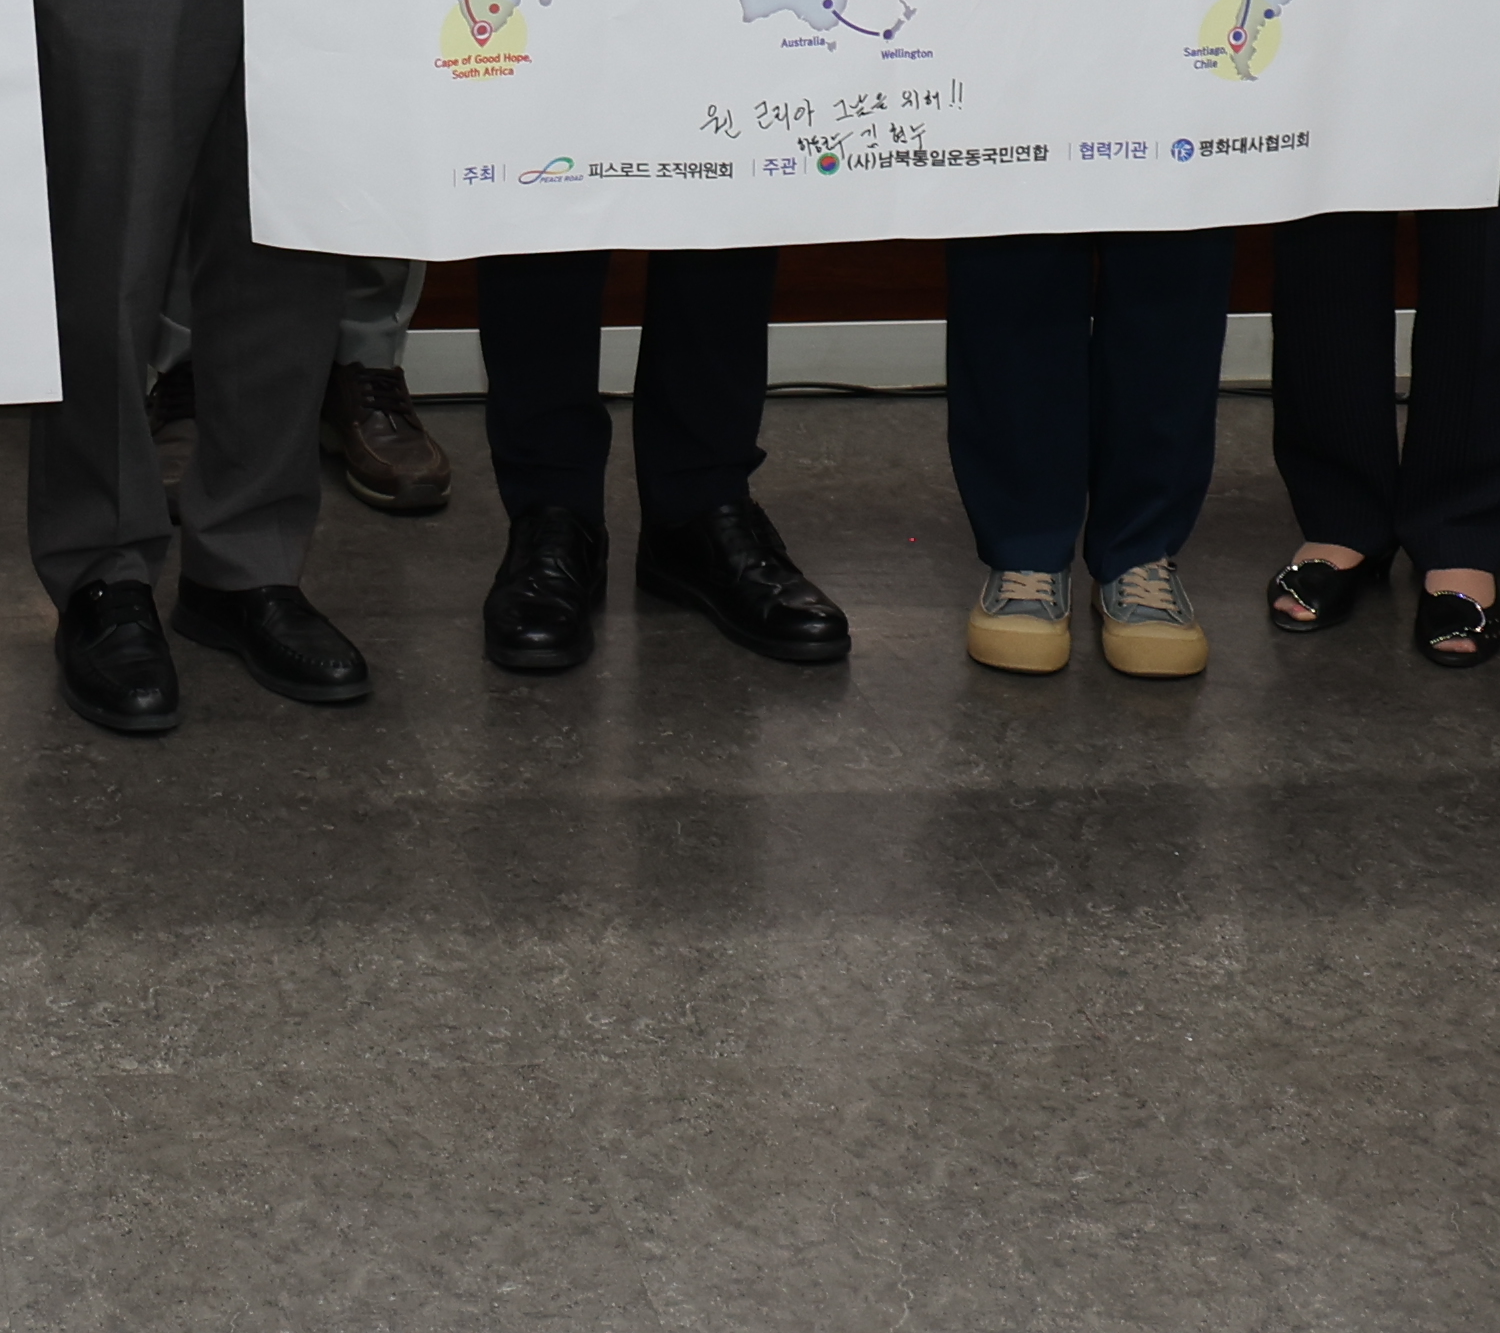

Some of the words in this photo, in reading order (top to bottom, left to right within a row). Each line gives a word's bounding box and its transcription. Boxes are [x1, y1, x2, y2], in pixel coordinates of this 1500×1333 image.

[781, 37, 826, 49] Australia
[434, 57, 460, 69] Cape
[461, 54, 473, 66] of
[474, 53, 501, 65] Good
[503, 51, 533, 66] Hope,
[881, 48, 934, 60] Wellington
[452, 67, 481, 80] South
[483, 65, 515, 78] Africa
[1193, 57, 1219, 70] Chile
[1079, 139, 1149, 161] 협력기관
[1198, 130, 1311, 157] 평화대사협의회
[762, 157, 798, 178] 주관
[847, 144, 1050, 173] (사)남북통일운동국민연합
[462, 164, 497, 185] 주최
[539, 176, 562, 184] PEACE
[564, 174, 585, 183] ROAD
[588, 162, 652, 180] 피스로드
[655, 161, 734, 180] 조직위원회
